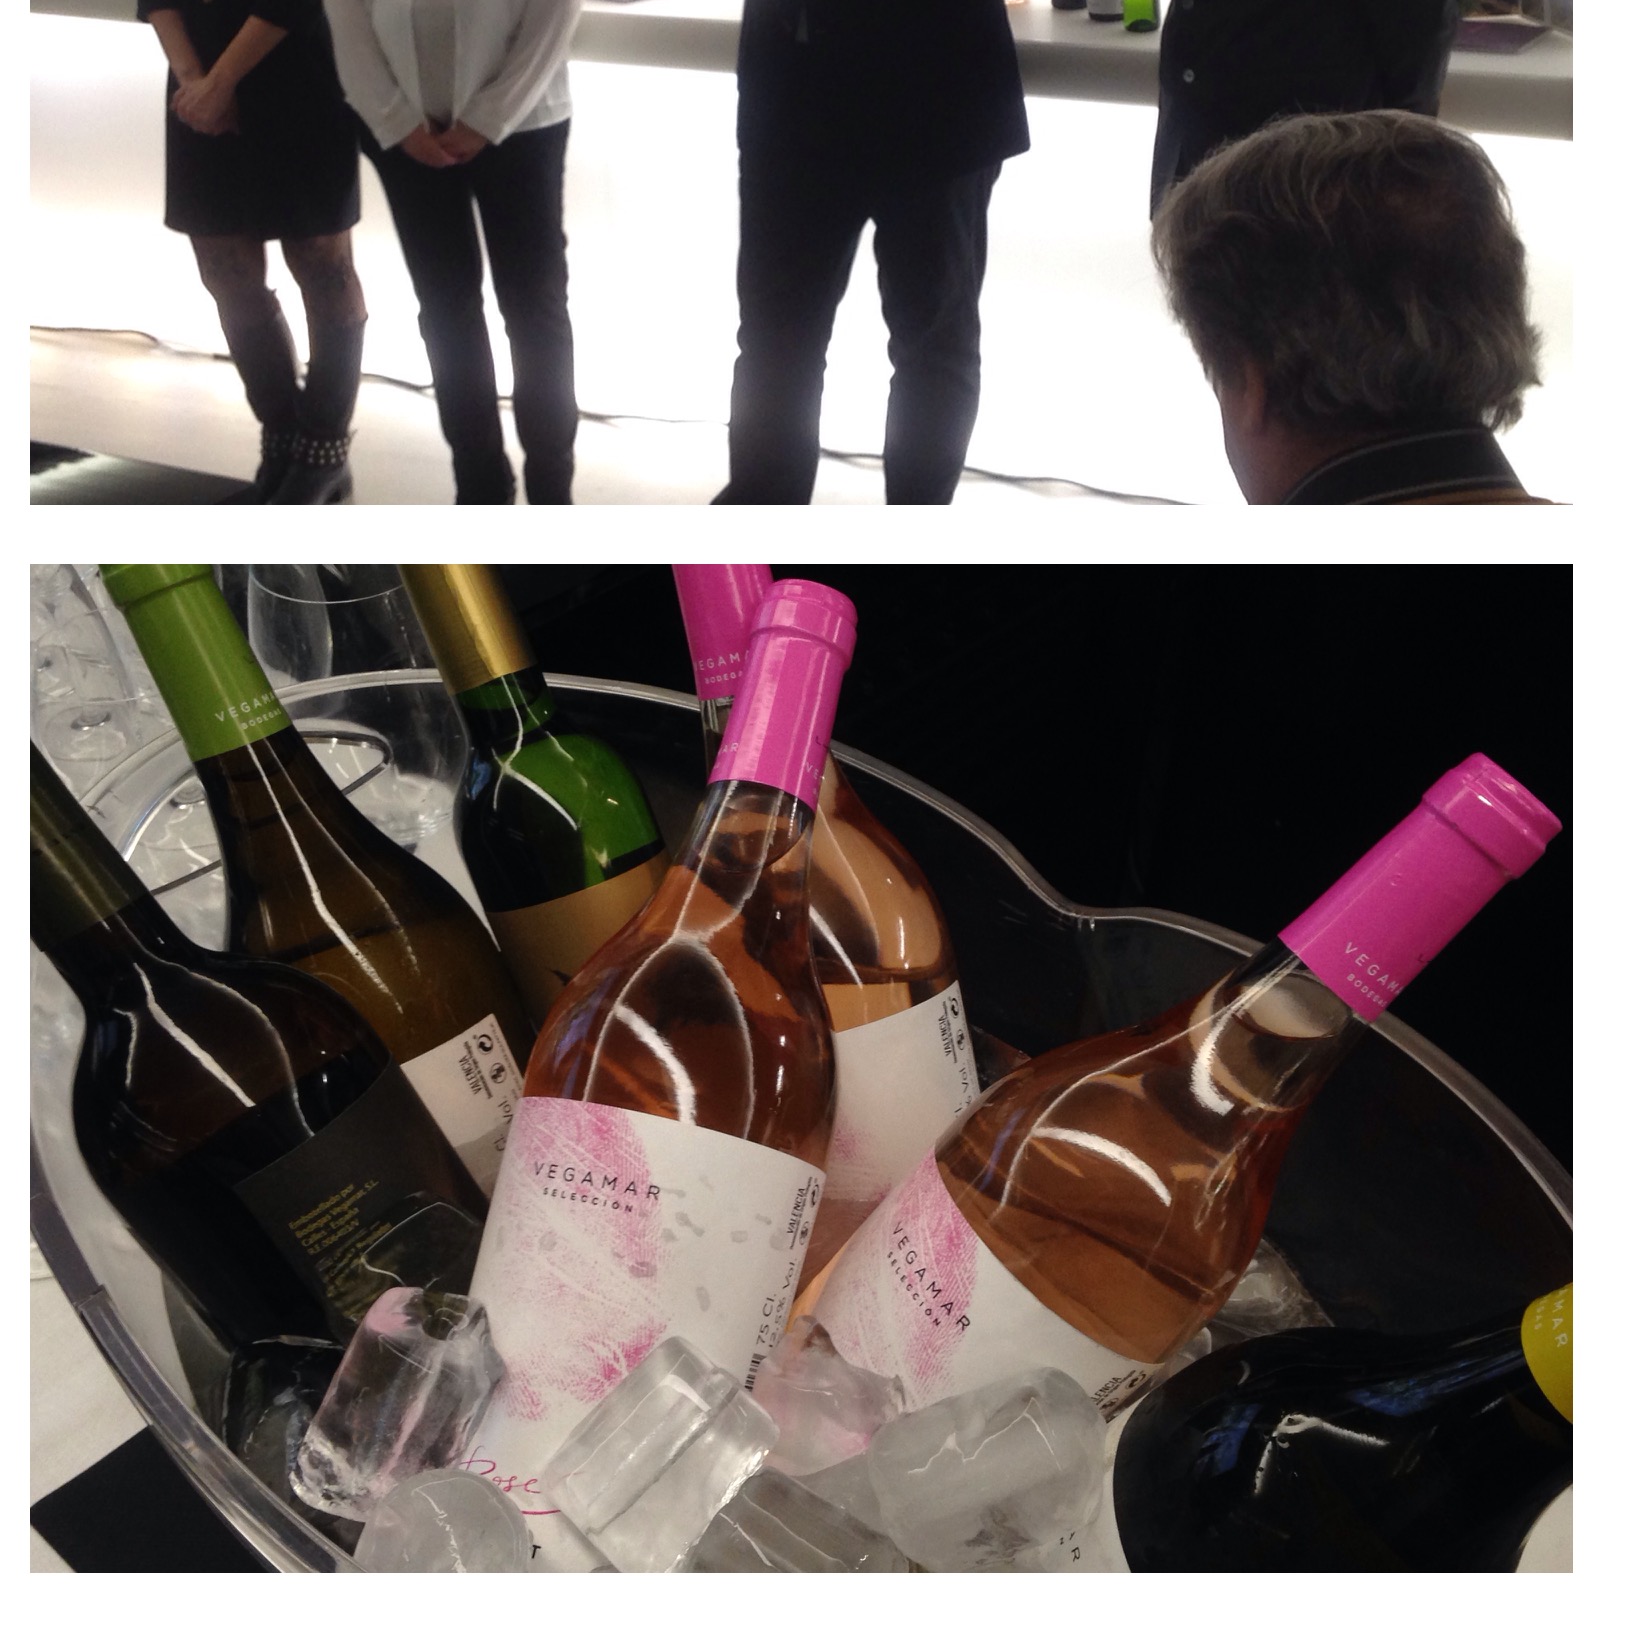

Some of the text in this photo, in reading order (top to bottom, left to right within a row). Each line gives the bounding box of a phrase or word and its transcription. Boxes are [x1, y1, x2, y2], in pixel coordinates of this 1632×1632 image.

[534, 1161, 660, 1201] VEGAMAR
[893, 1222, 971, 1332] VEGAMAR
[756, 1323, 770, 1346] 75
